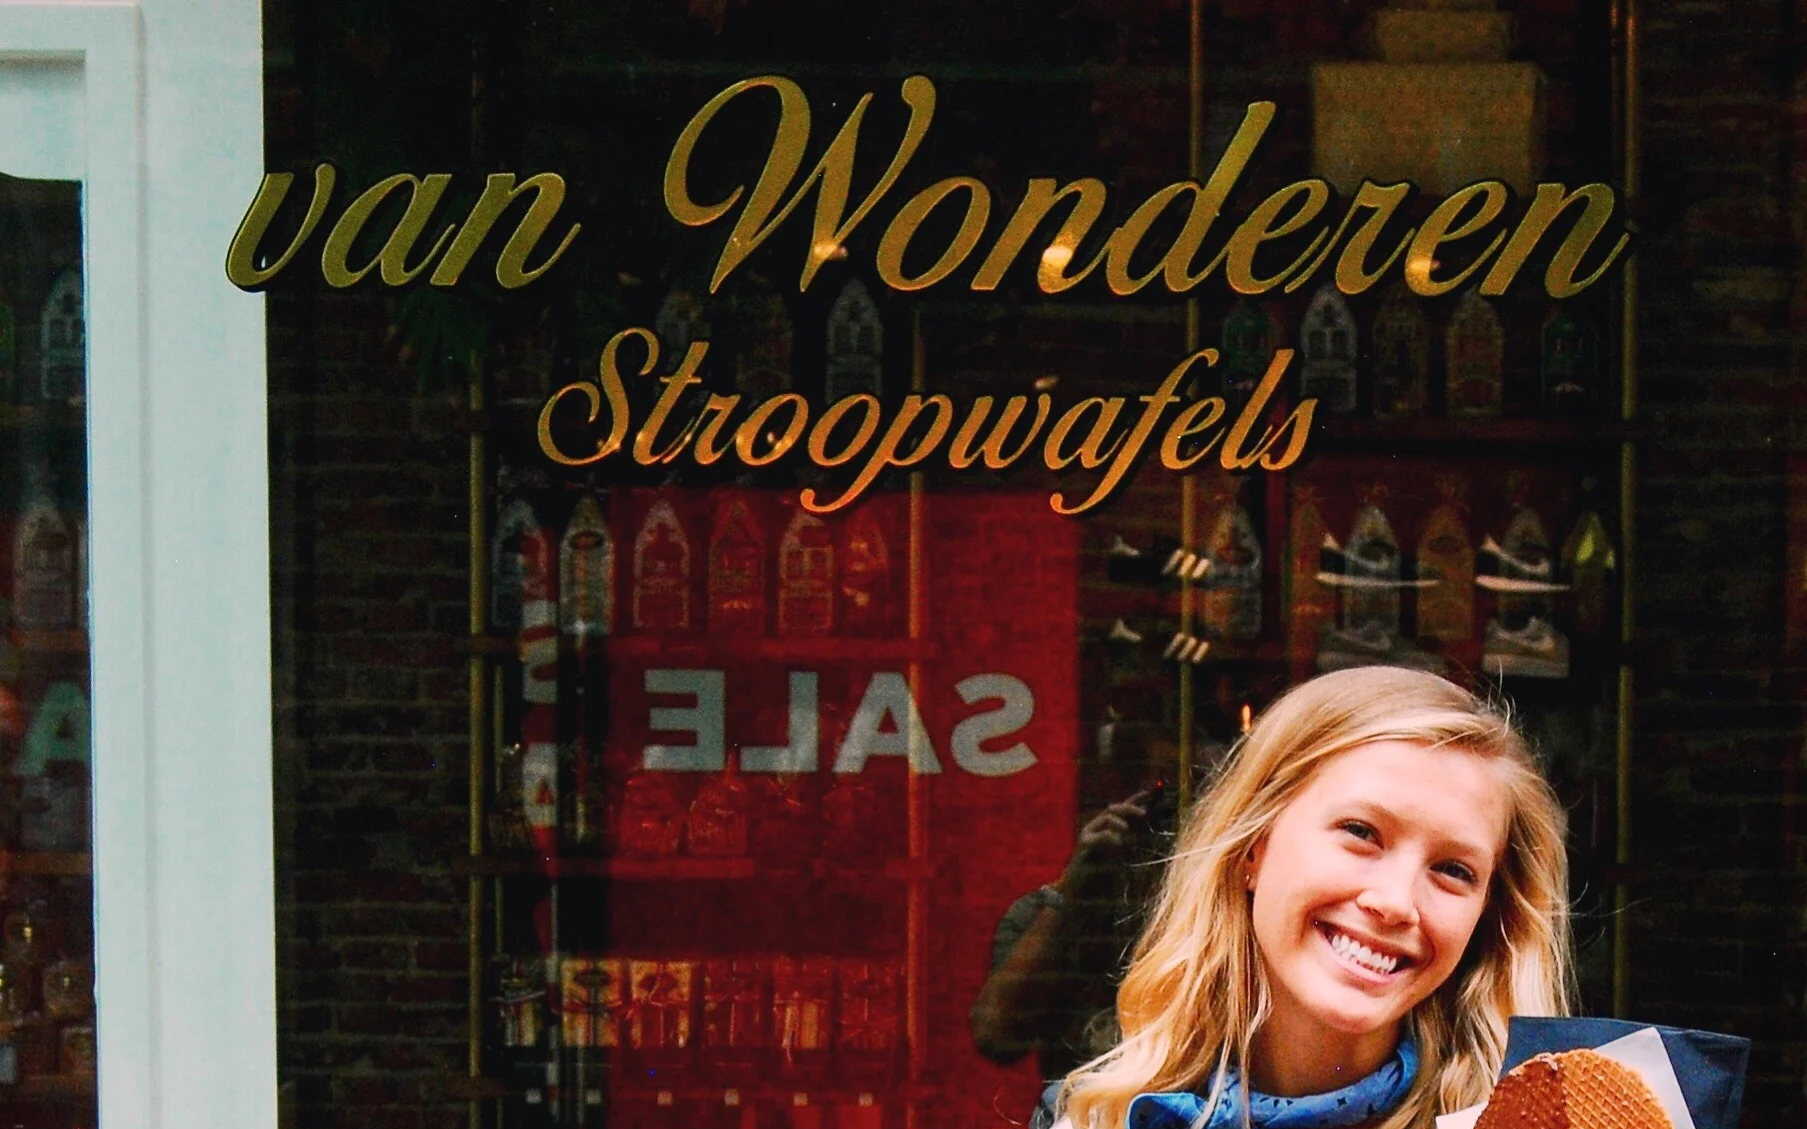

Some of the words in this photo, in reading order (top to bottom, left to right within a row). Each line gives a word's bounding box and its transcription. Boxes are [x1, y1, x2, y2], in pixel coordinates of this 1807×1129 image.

[225, 162, 582, 291] van
[663, 74, 1631, 299] Wonderen
[537, 326, 1318, 516] Stroopwafels
